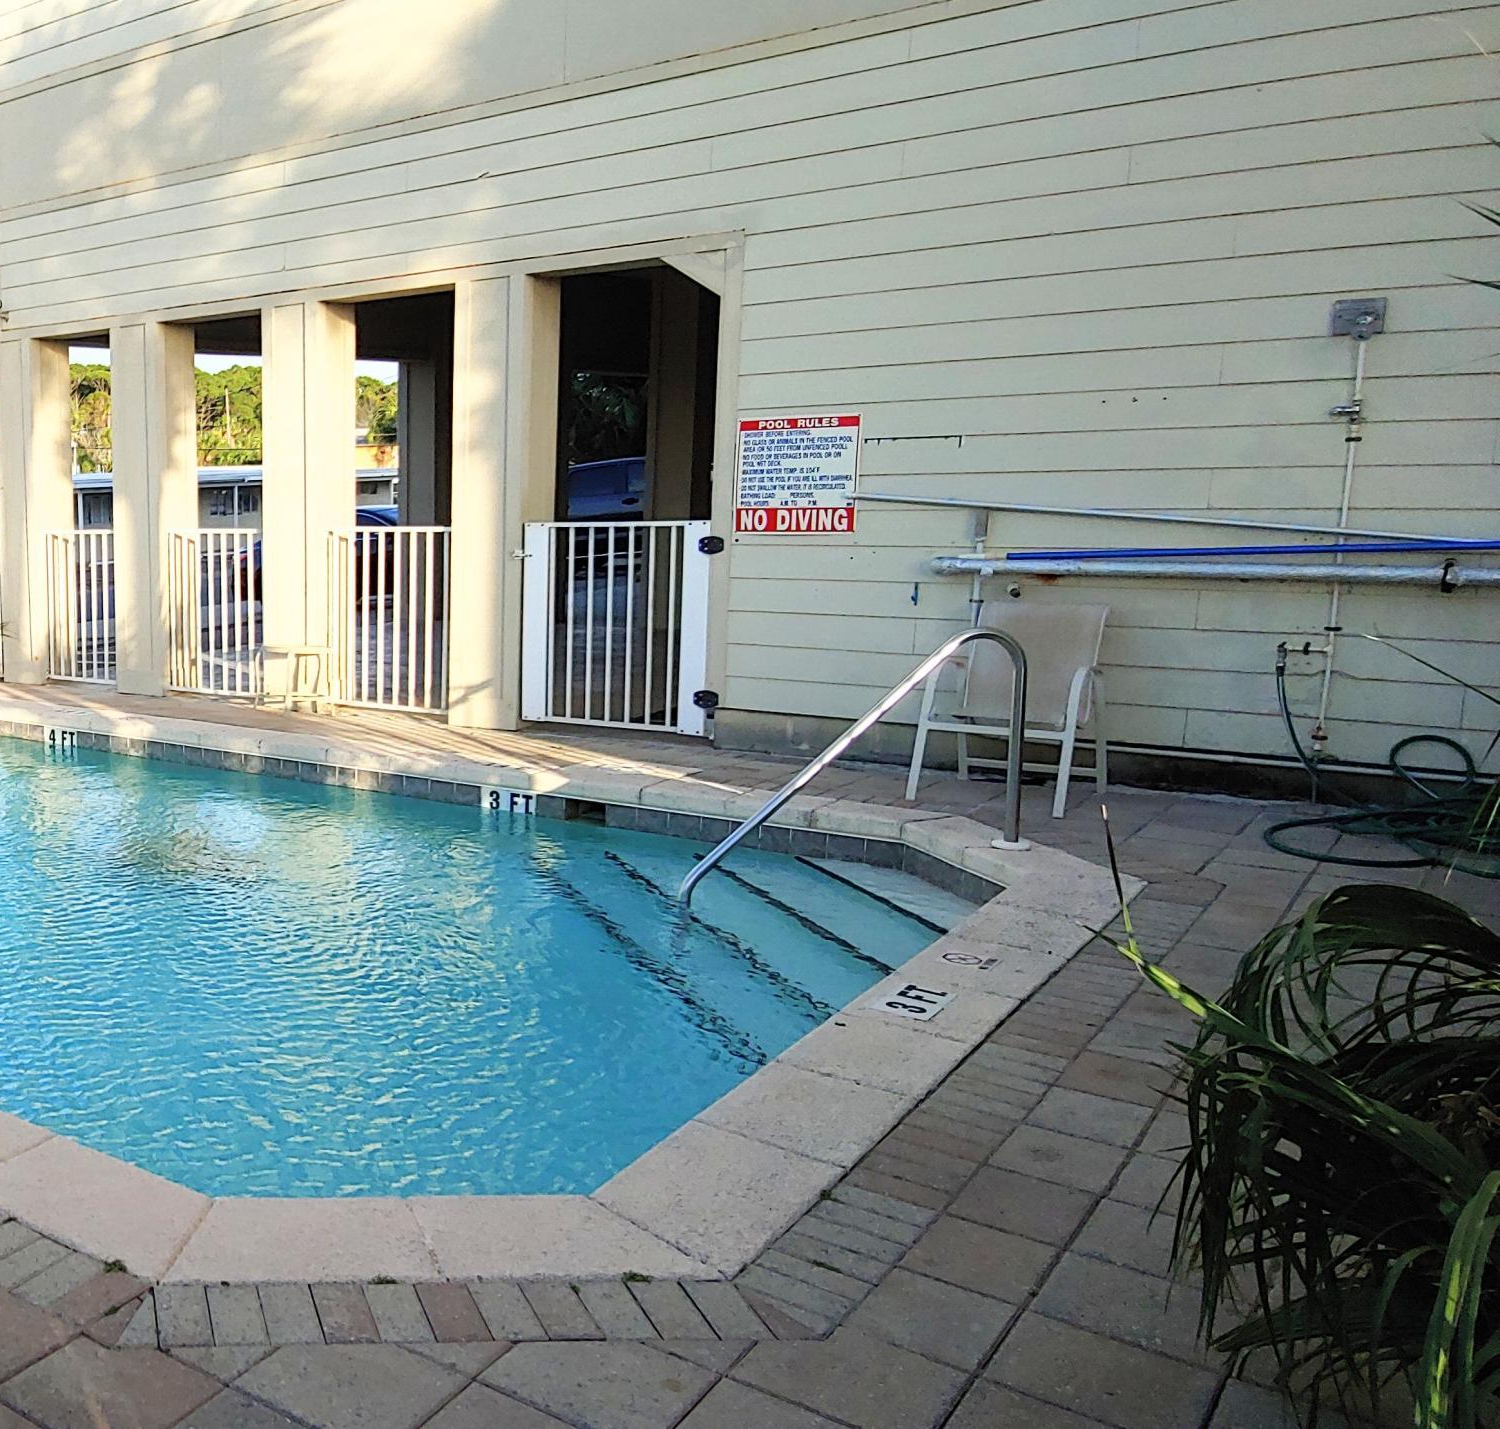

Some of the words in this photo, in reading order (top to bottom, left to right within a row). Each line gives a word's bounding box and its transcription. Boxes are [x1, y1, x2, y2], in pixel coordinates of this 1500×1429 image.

[759, 420, 790, 429] POOL
[797, 418, 839, 427] RULES
[740, 510, 768, 530] NO
[776, 509, 848, 531] DIVING
[49, 729, 56, 745] 4
[489, 790, 500, 810] 3
[886, 1002, 927, 1014] 3
